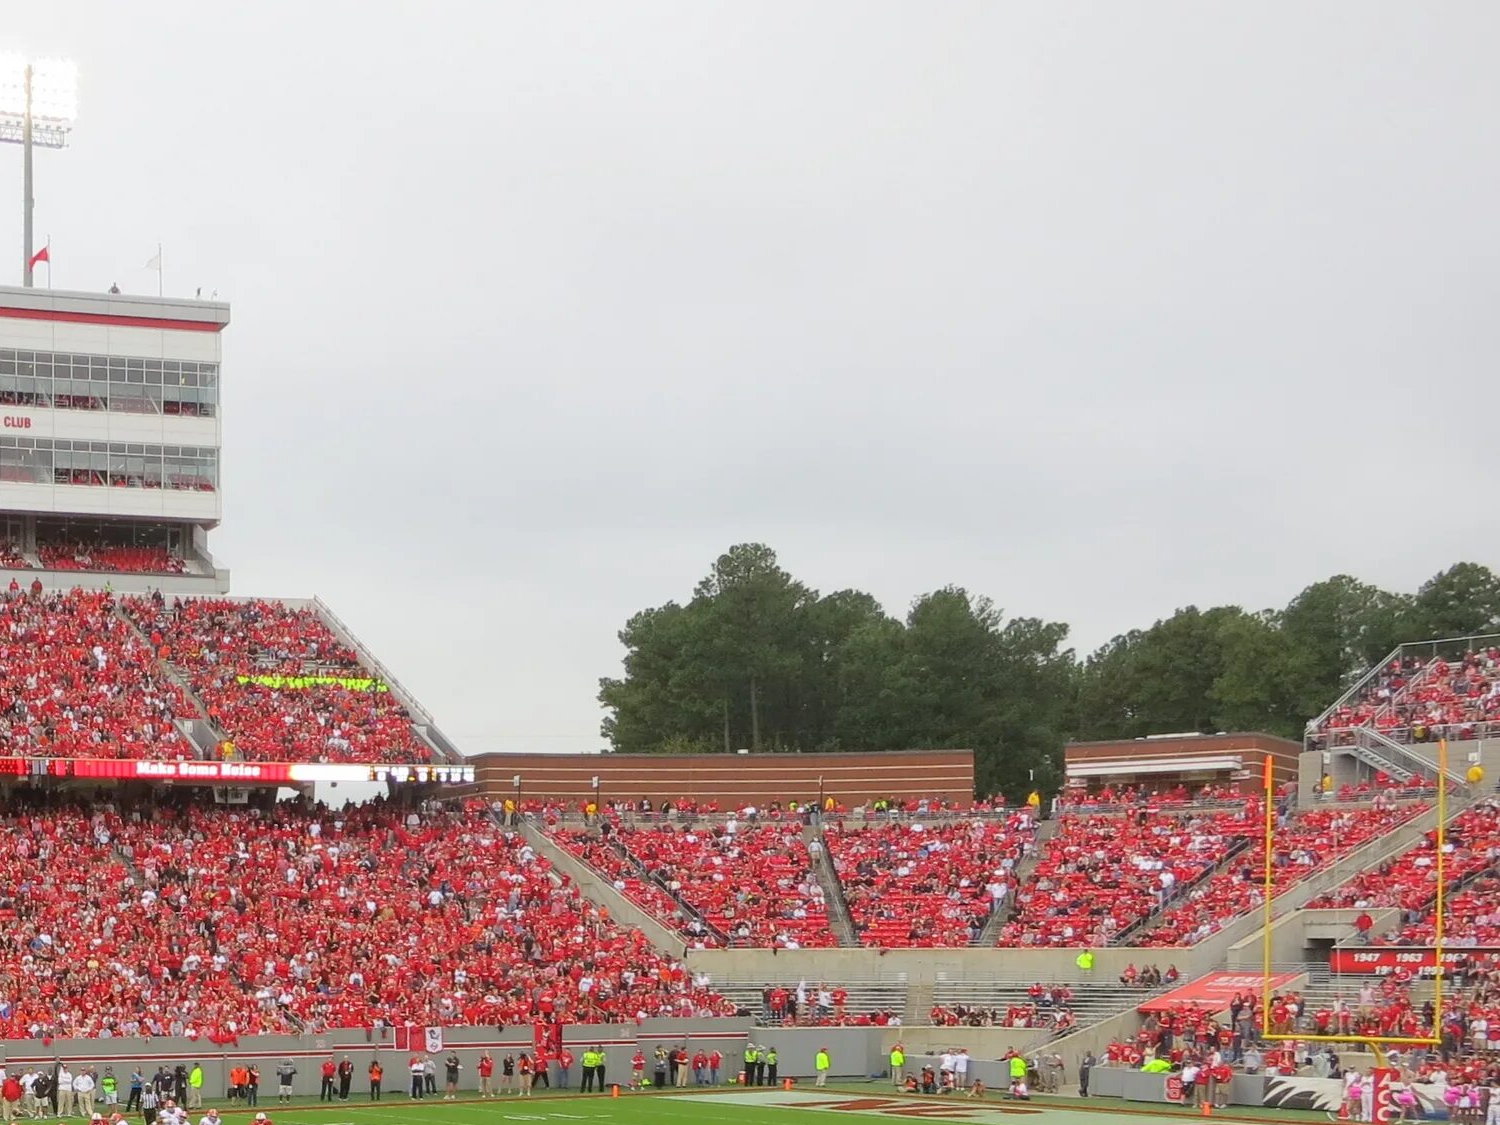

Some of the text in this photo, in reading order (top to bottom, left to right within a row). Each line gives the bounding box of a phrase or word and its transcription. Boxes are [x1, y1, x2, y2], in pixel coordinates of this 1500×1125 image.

[3, 416, 32, 429] CLUB
[136, 761, 260, 776] Make Some Noise
[1353, 953, 1380, 962] 1947
[1395, 953, 1423, 962] 1963
